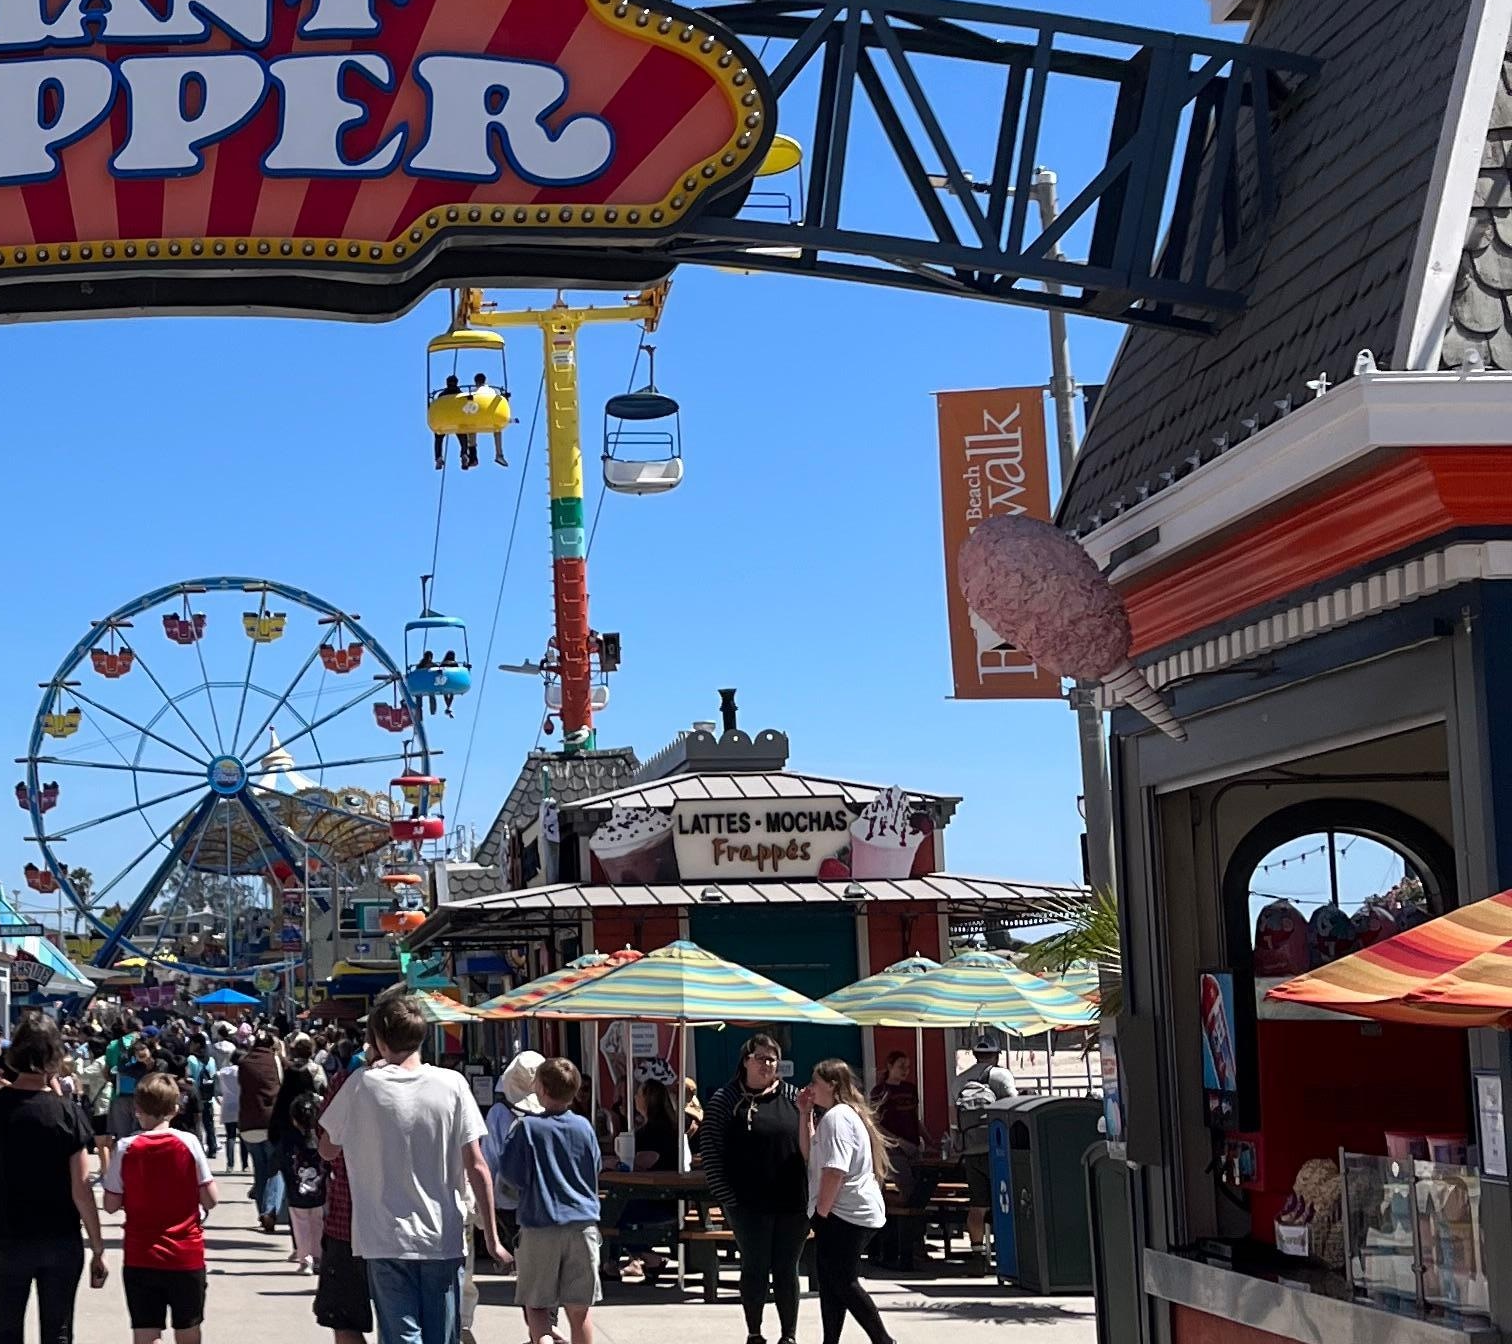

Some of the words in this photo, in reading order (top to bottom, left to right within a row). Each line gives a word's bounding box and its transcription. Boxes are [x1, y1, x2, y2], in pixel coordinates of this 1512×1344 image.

[965, 465, 982, 521] Beach
[678, 812, 751, 835] LATTES
[766, 809, 848, 833] MOCHAS
[711, 837, 811, 873] Frappés
